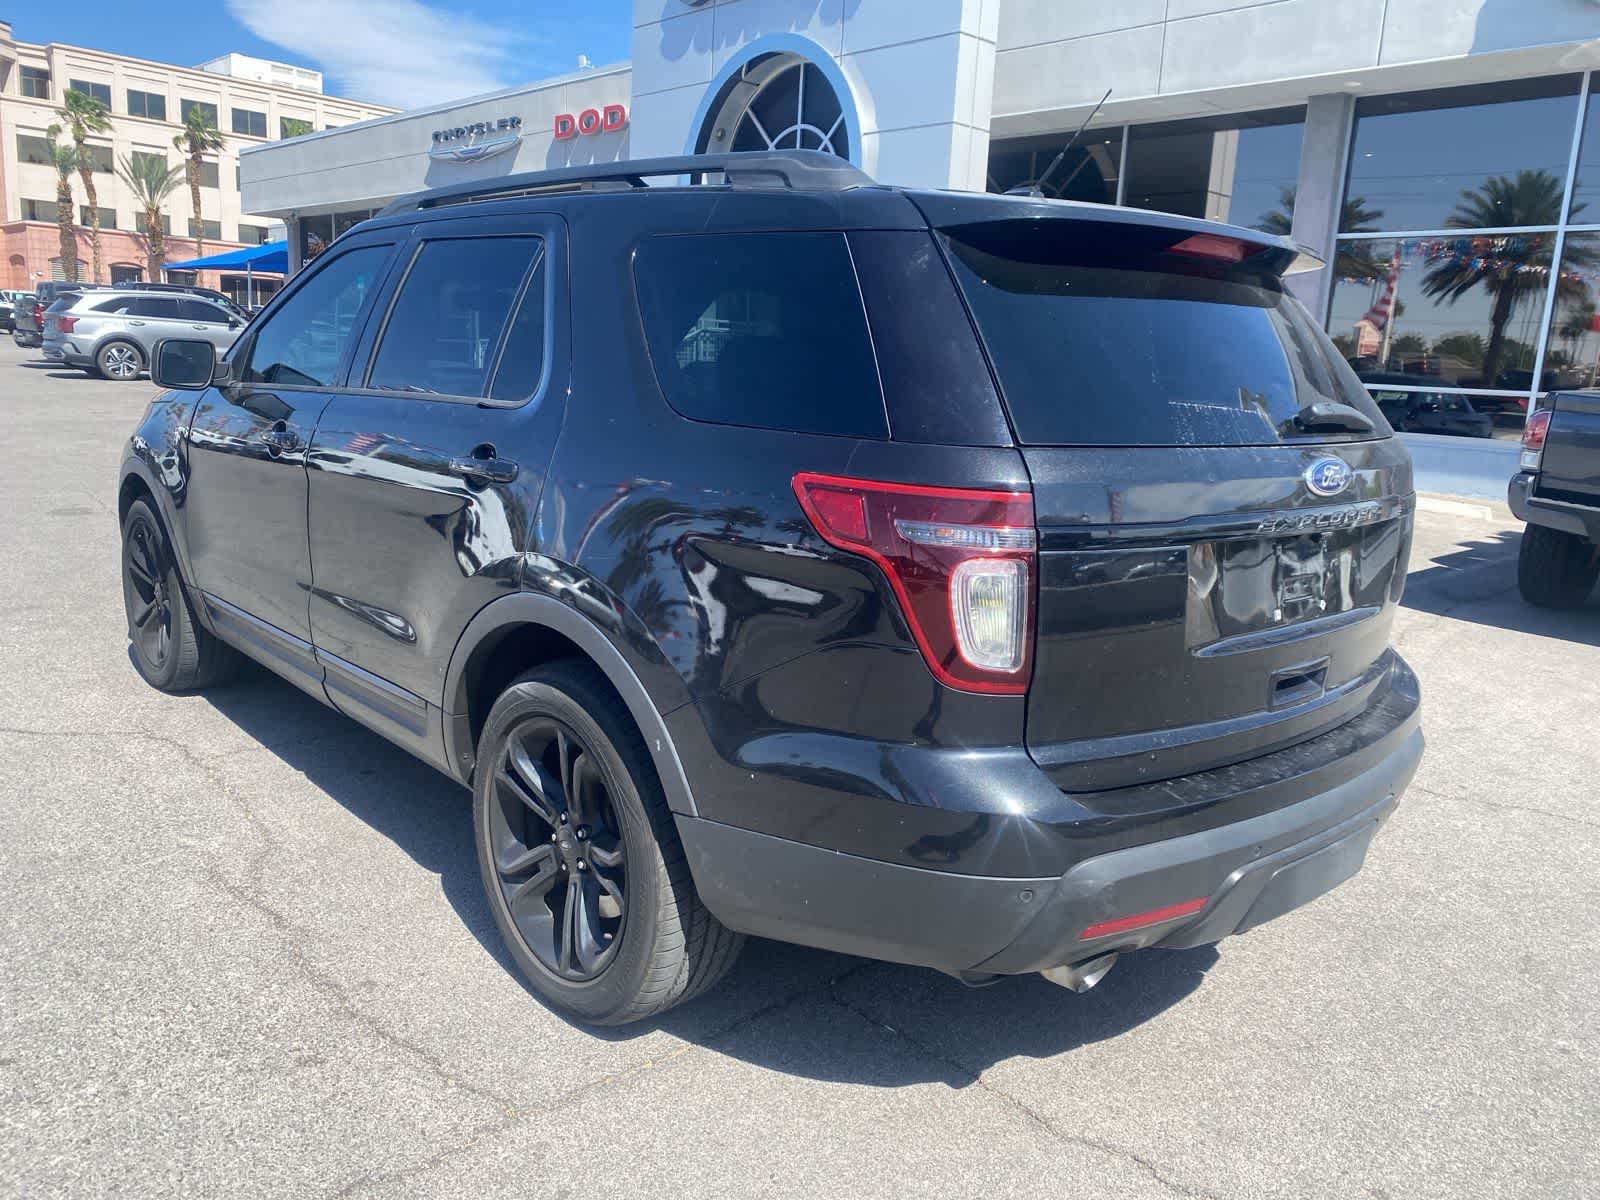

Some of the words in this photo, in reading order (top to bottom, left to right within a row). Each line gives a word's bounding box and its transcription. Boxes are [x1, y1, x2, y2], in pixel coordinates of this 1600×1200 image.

[432, 116, 522, 141] CHRYSLER
[1320, 463, 1347, 488] Ford
[1256, 505, 1382, 532] EXPLORER
